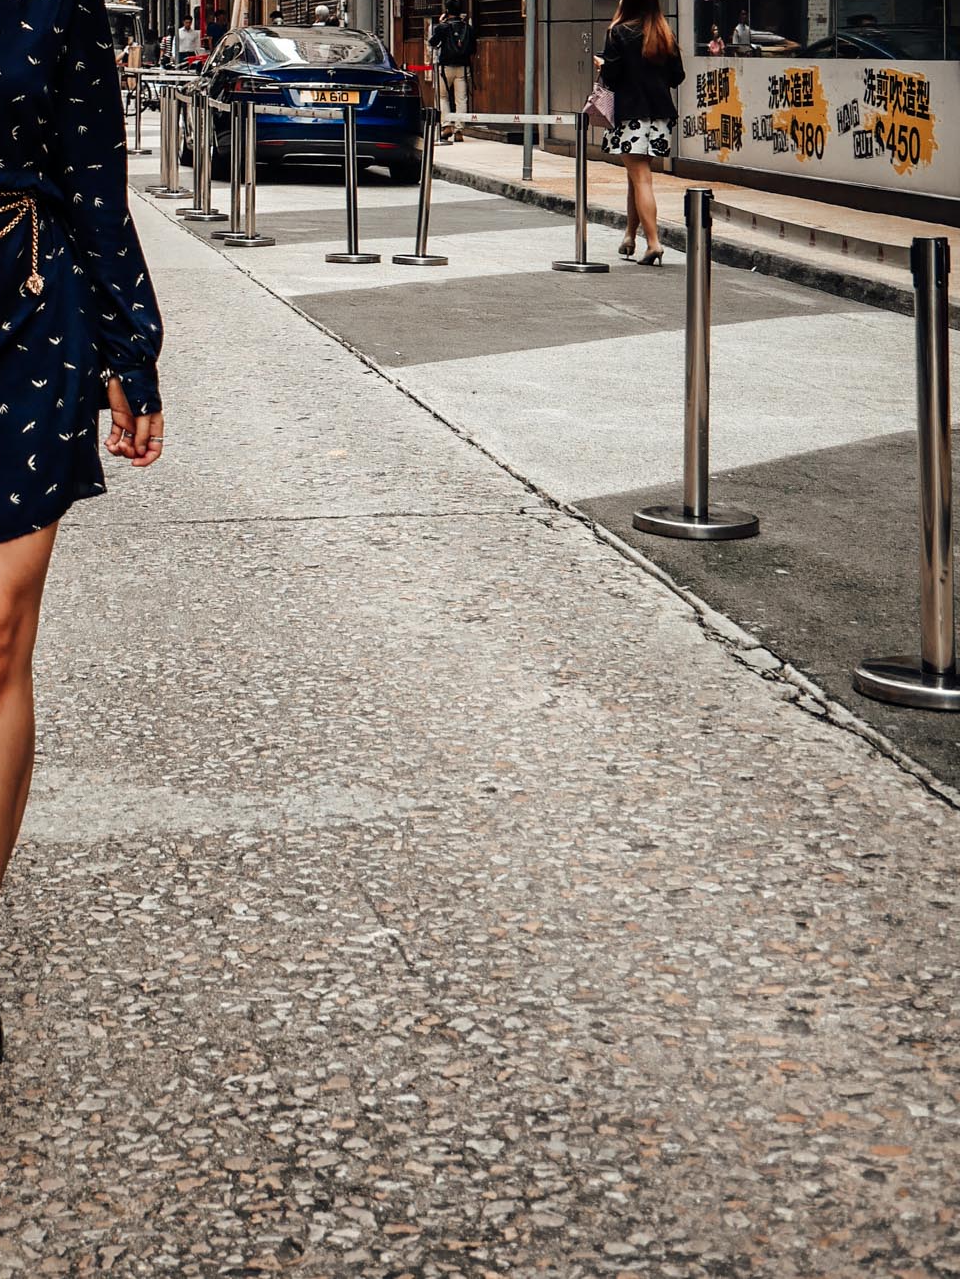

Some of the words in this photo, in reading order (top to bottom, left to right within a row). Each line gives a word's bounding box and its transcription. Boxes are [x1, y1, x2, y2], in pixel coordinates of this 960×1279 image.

[329, 91, 349, 102] 610
[696, 67, 730, 108] 髮型師
[768, 71, 814, 109] 洗吹造型
[863, 67, 930, 120] 洗剪吹造型
[721, 114, 743, 152] 團隊
[836, 98, 860, 136] HAIR
[790, 115, 824, 160] $180
[853, 129, 873, 159] CUT
[874, 116, 921, 165] $450
